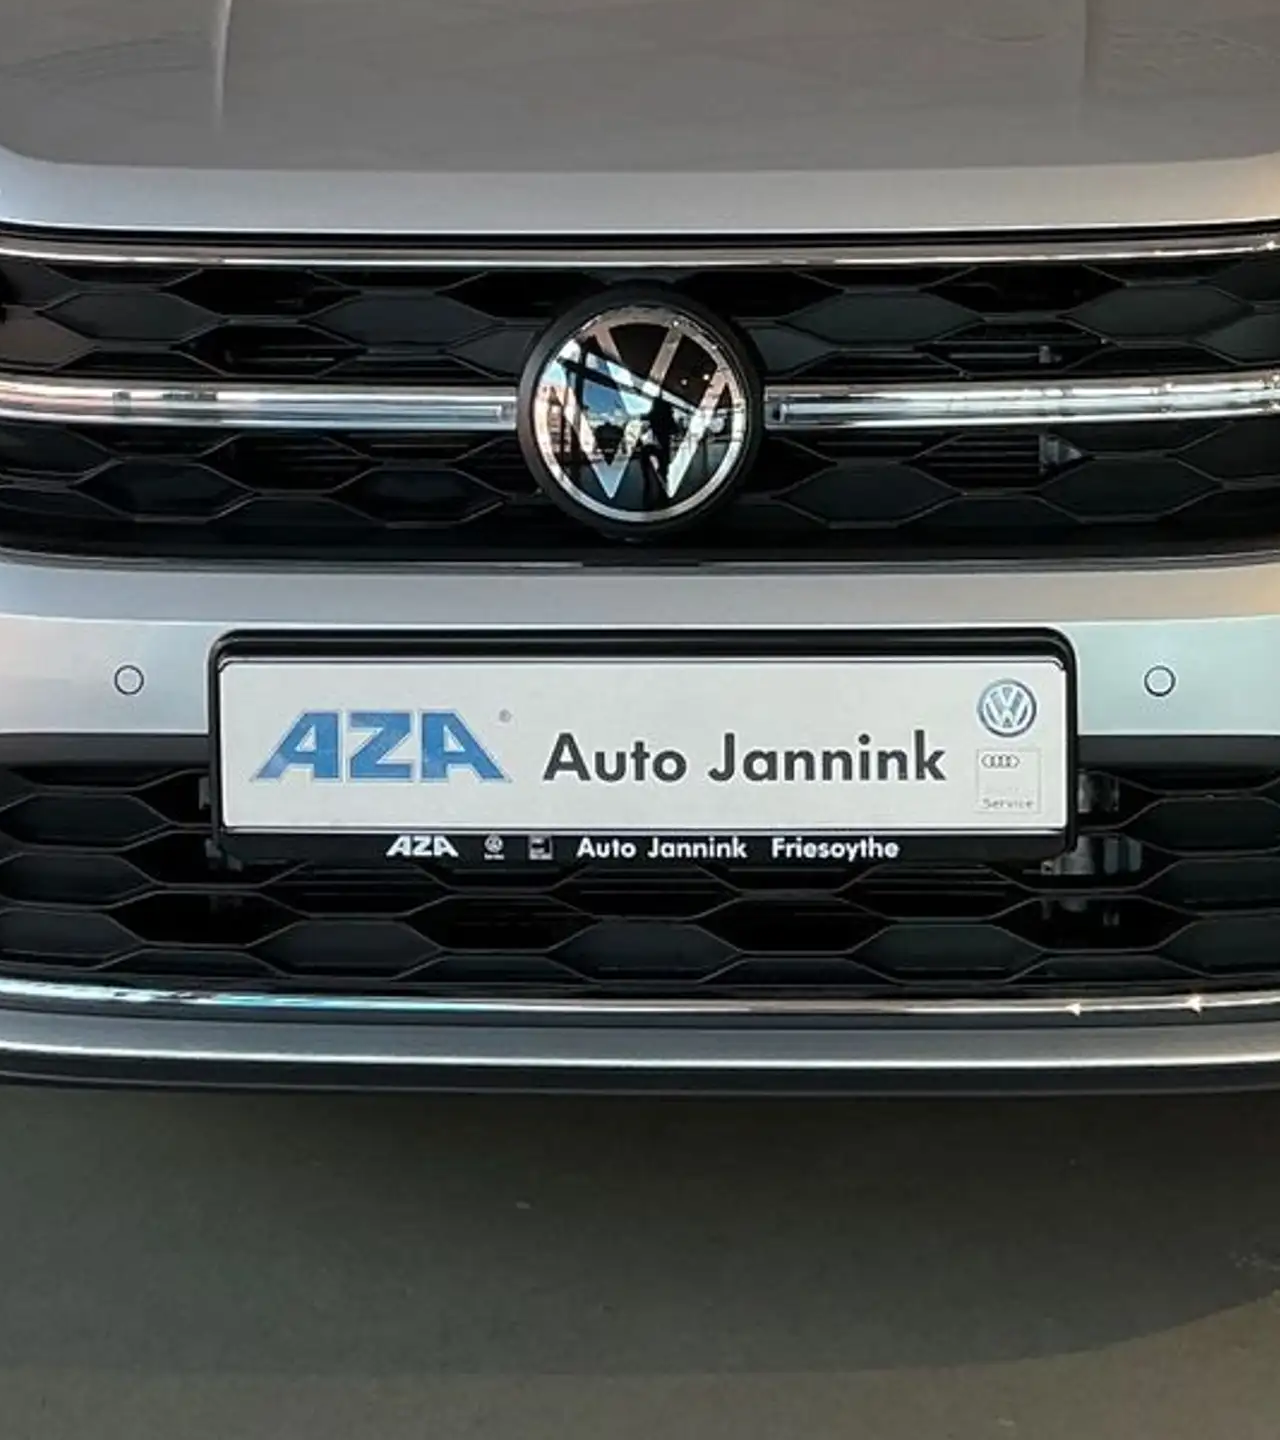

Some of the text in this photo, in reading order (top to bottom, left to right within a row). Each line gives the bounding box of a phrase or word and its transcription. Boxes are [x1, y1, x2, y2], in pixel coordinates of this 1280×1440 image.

[534, 306, 748, 522] VW
[250, 709, 946, 783] AZA Auto Jannink
[982, 797, 1035, 809] Service
[385, 836, 459, 858] AZA
[576, 836, 637, 859] Auto
[647, 836, 749, 859] Jannink
[771, 836, 901, 861] Friesoythe
